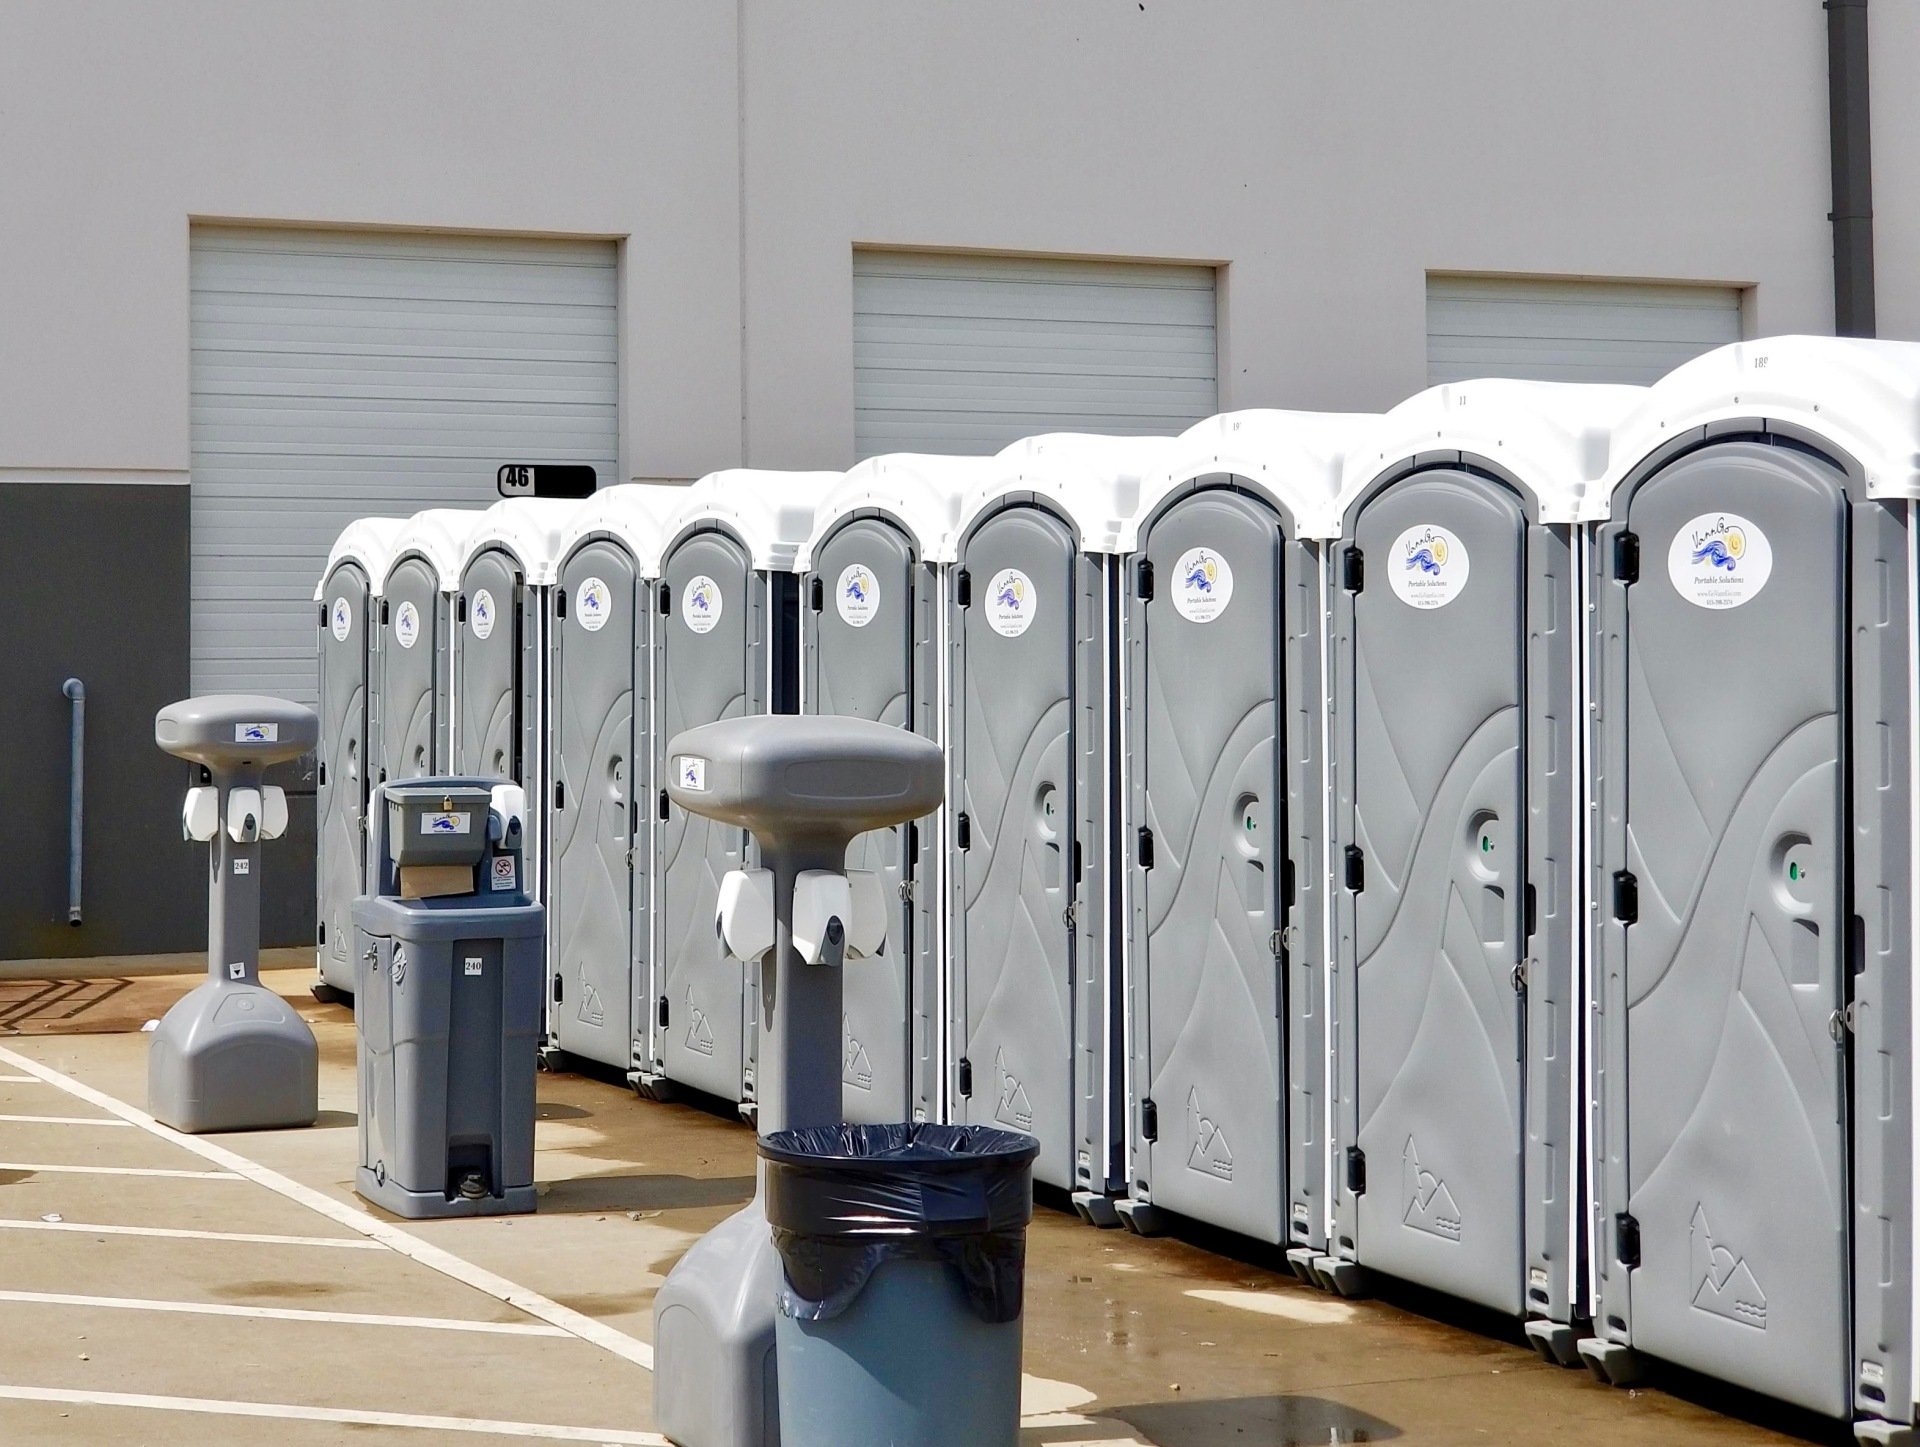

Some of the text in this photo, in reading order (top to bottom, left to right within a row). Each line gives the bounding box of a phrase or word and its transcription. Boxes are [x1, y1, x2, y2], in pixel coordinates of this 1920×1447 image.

[505, 467, 529, 487] 46
[1694, 575, 1744, 585] Portable Solutions
[234, 862, 248, 870] 242
[465, 961, 481, 970] 240
